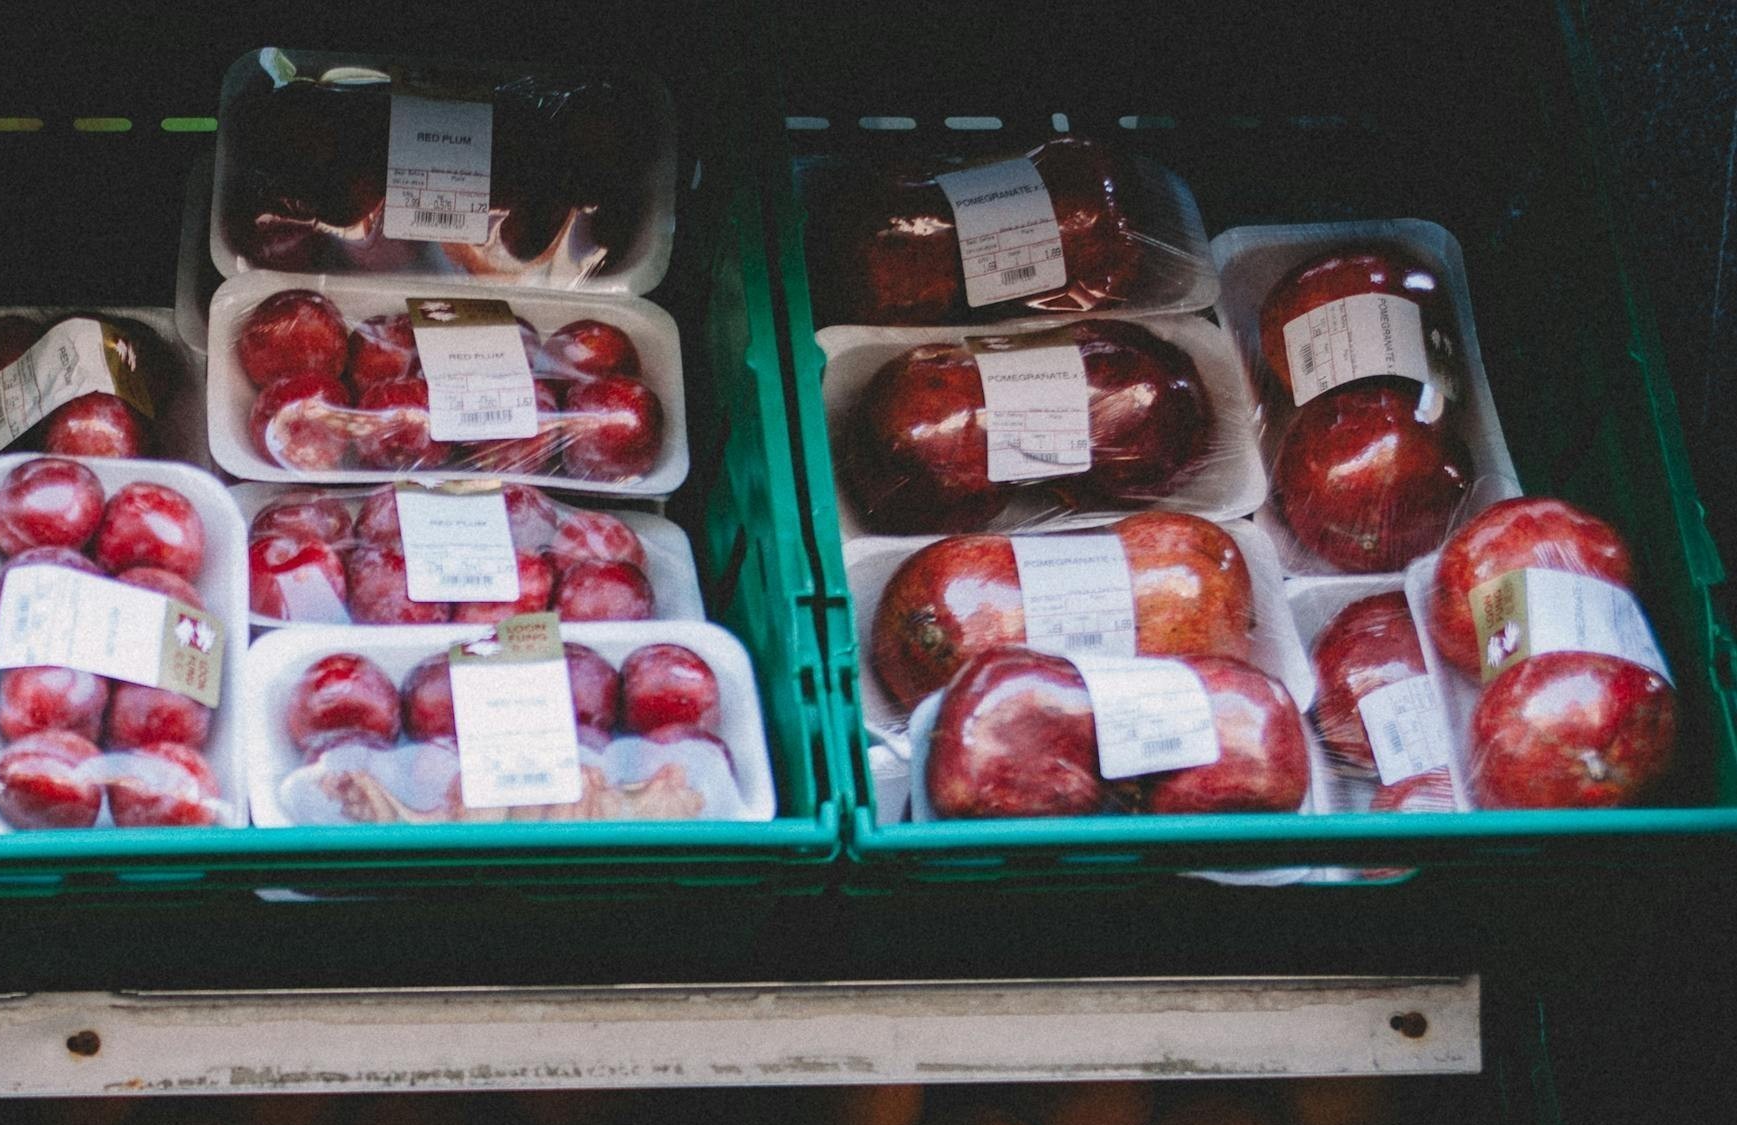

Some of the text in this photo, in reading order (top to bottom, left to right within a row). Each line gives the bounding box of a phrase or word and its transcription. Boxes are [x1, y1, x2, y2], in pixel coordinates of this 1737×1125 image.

[417, 132, 472, 145] RED PLUM
[987, 371, 1069, 383] POMEGRANATE
